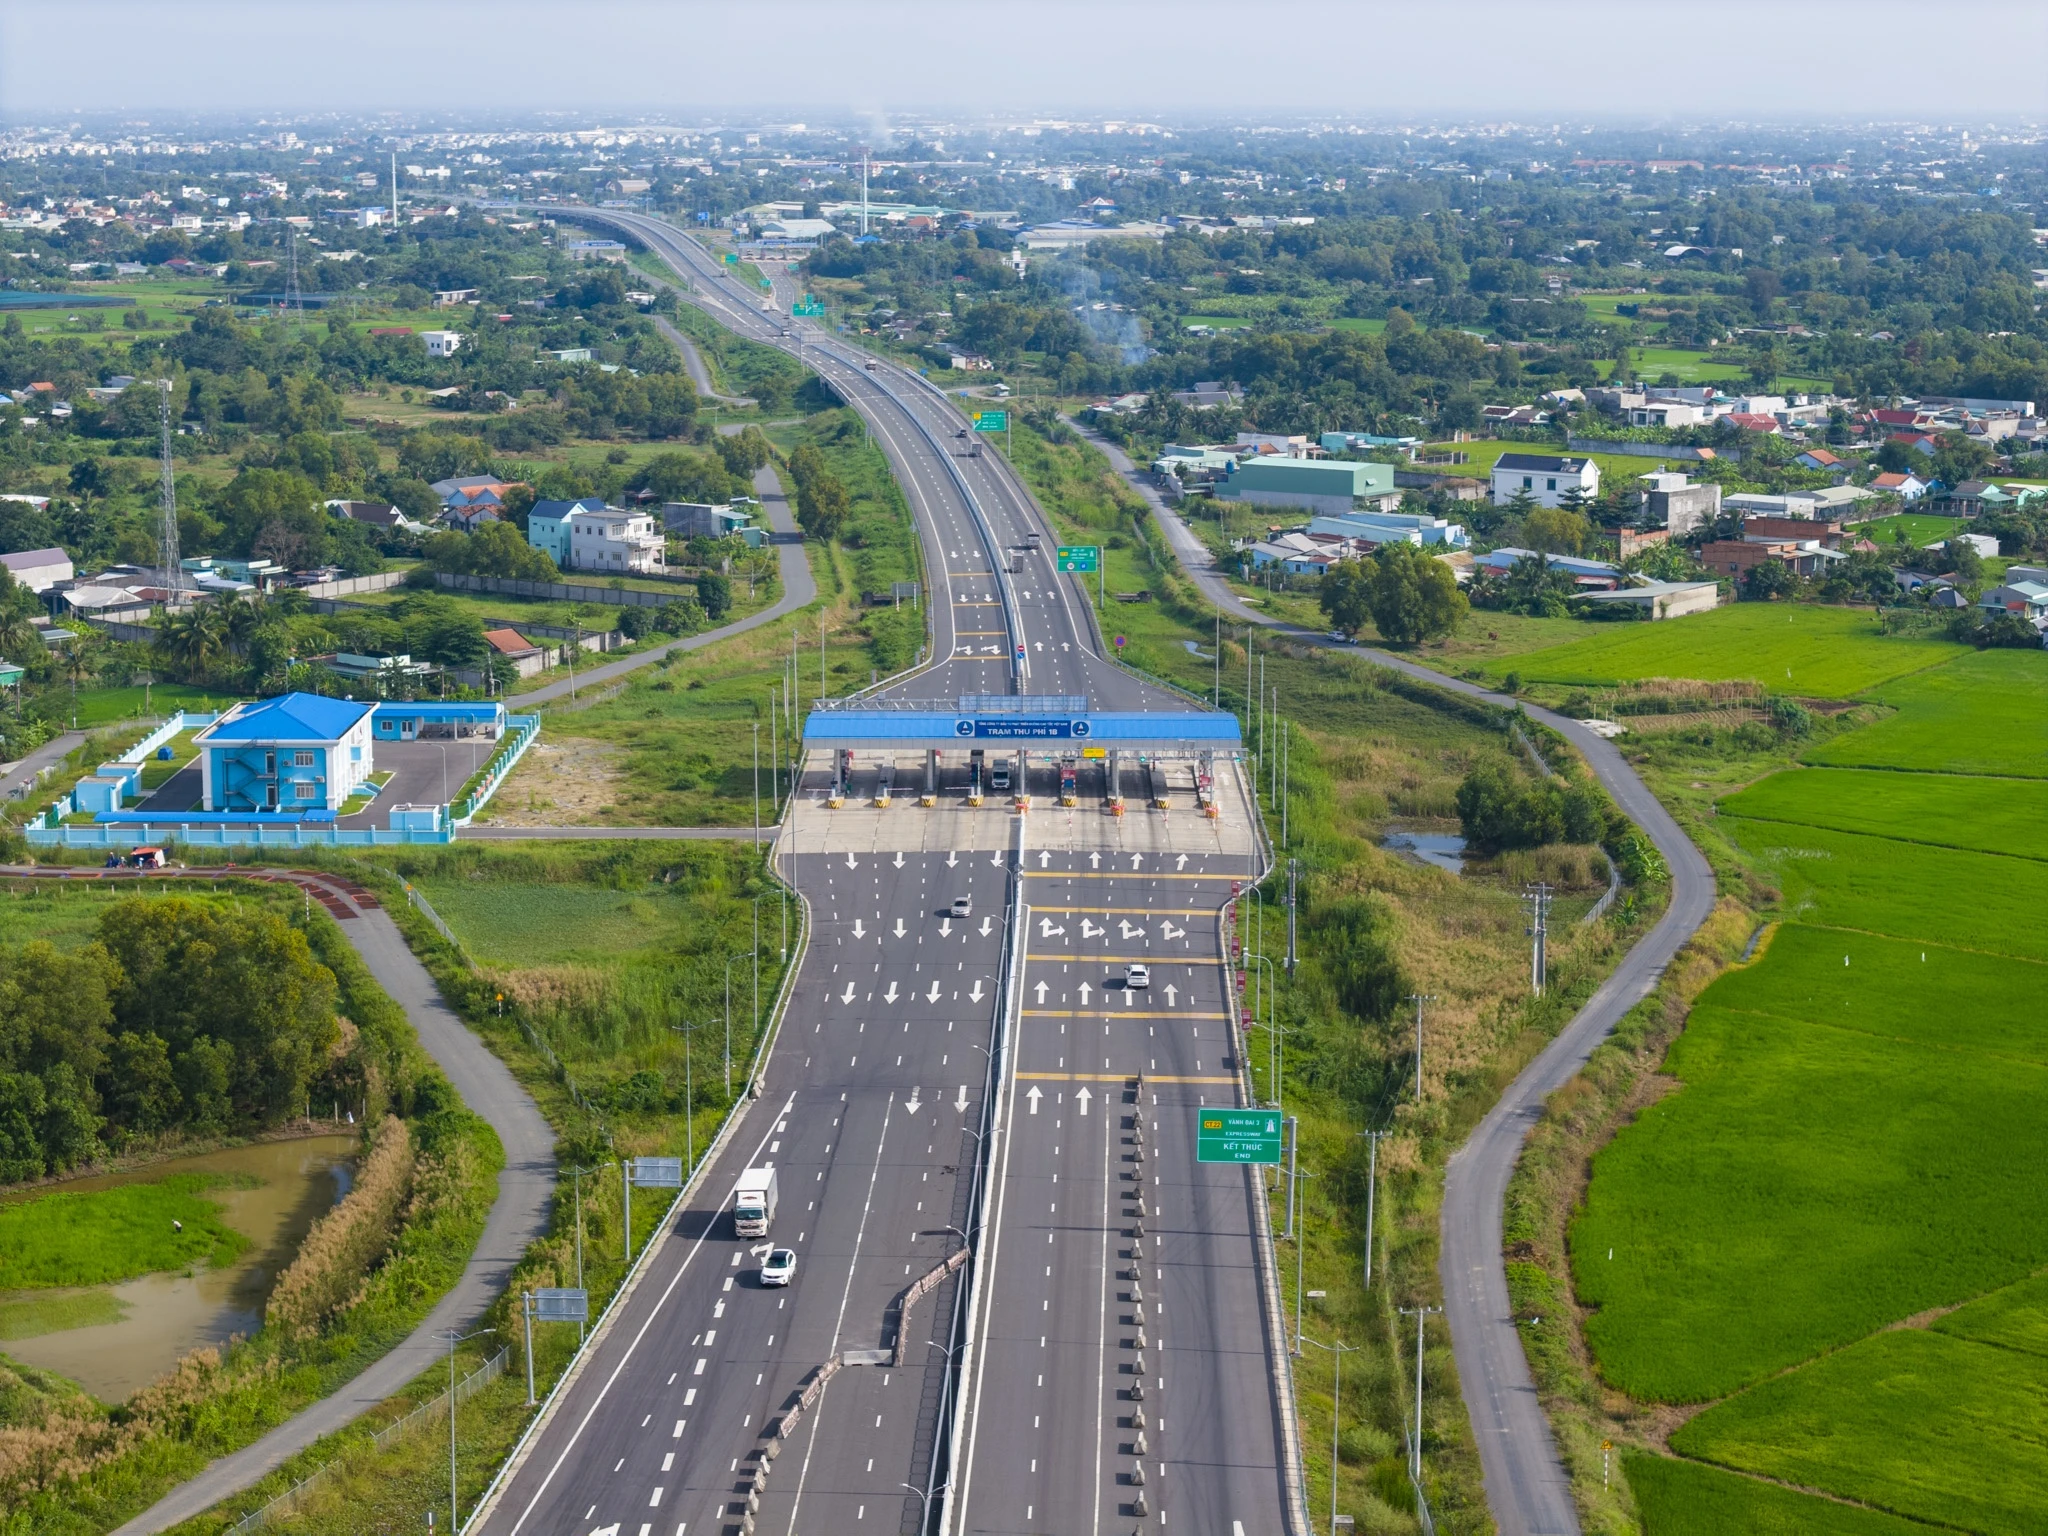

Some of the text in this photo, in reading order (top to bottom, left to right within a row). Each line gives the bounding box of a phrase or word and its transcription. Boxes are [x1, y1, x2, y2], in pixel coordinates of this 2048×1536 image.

[987, 728, 1011, 737] TRẠM
[1032, 727, 1046, 735] PHÍ
[1223, 1141, 1239, 1150] KẾT
